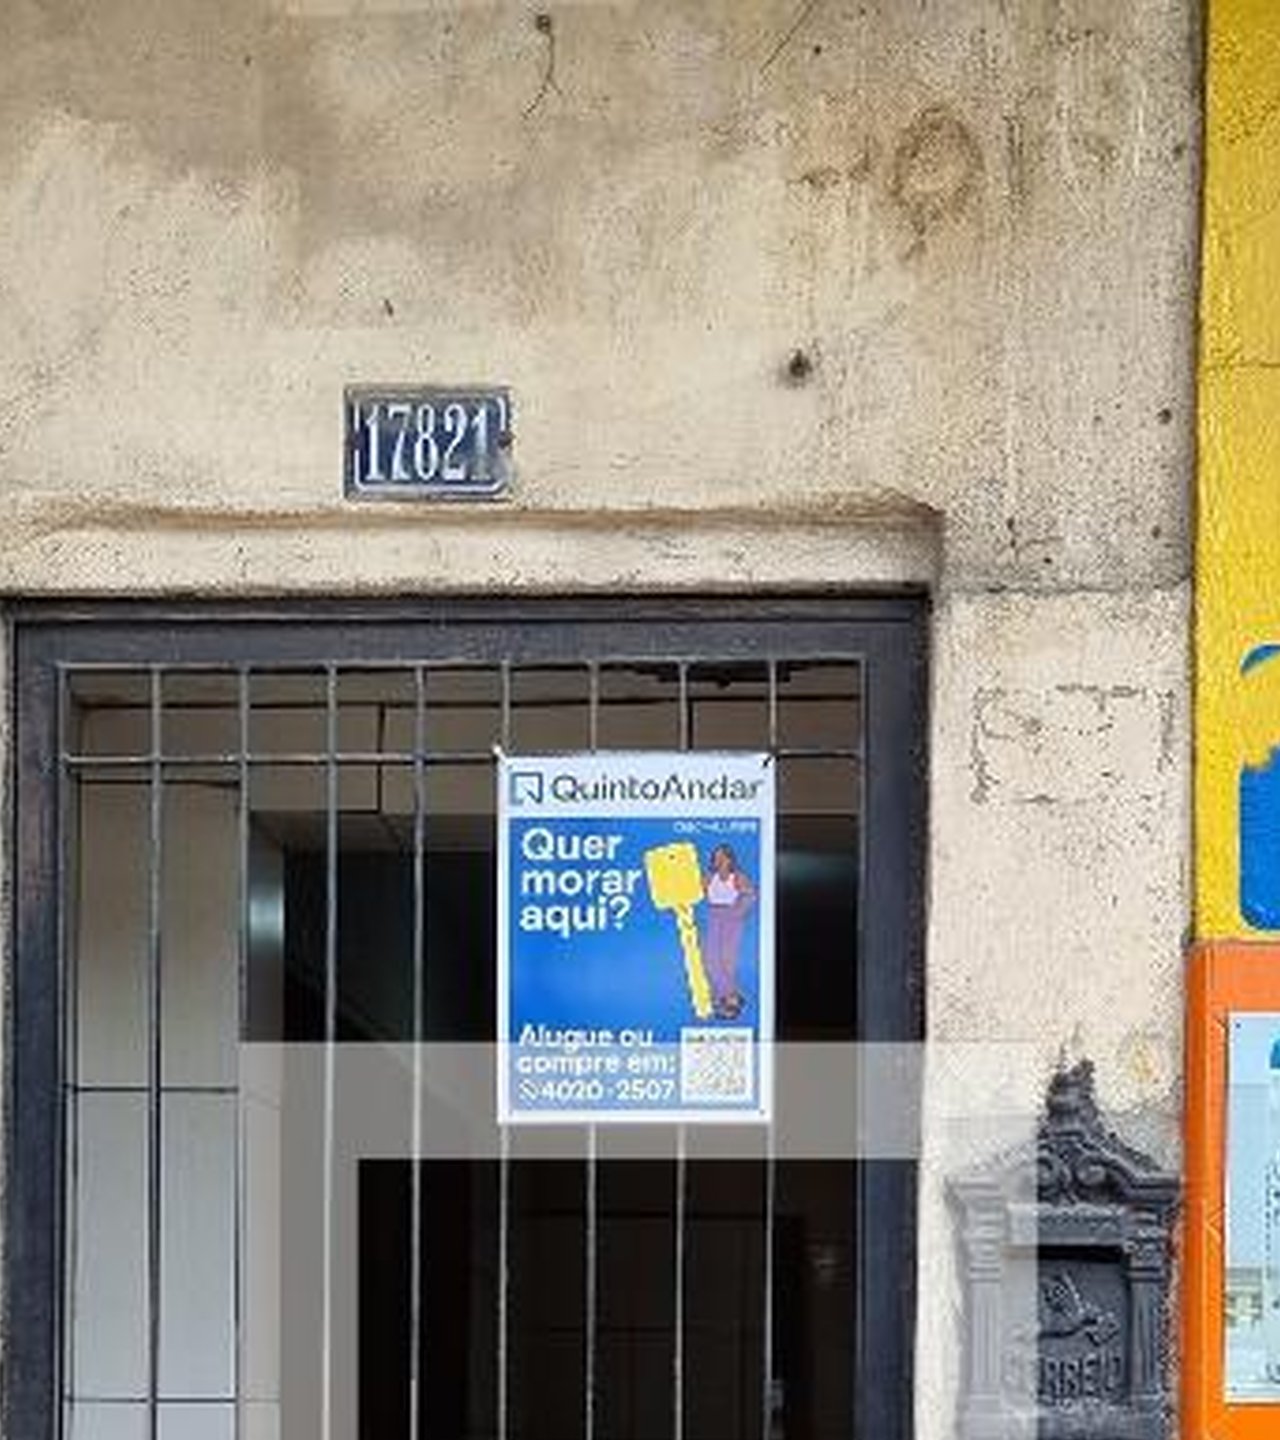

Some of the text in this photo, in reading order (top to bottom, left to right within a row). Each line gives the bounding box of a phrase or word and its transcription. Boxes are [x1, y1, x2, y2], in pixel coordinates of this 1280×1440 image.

[364, 402, 492, 481] 17821
[550, 774, 763, 802] QuintoAndar
[522, 828, 622, 861] Quer
[522, 869, 641, 895] morar
[520, 897, 631, 939] aqui?
[519, 1024, 653, 1053] Alugue ou
[519, 1052, 676, 1081] compre em:
